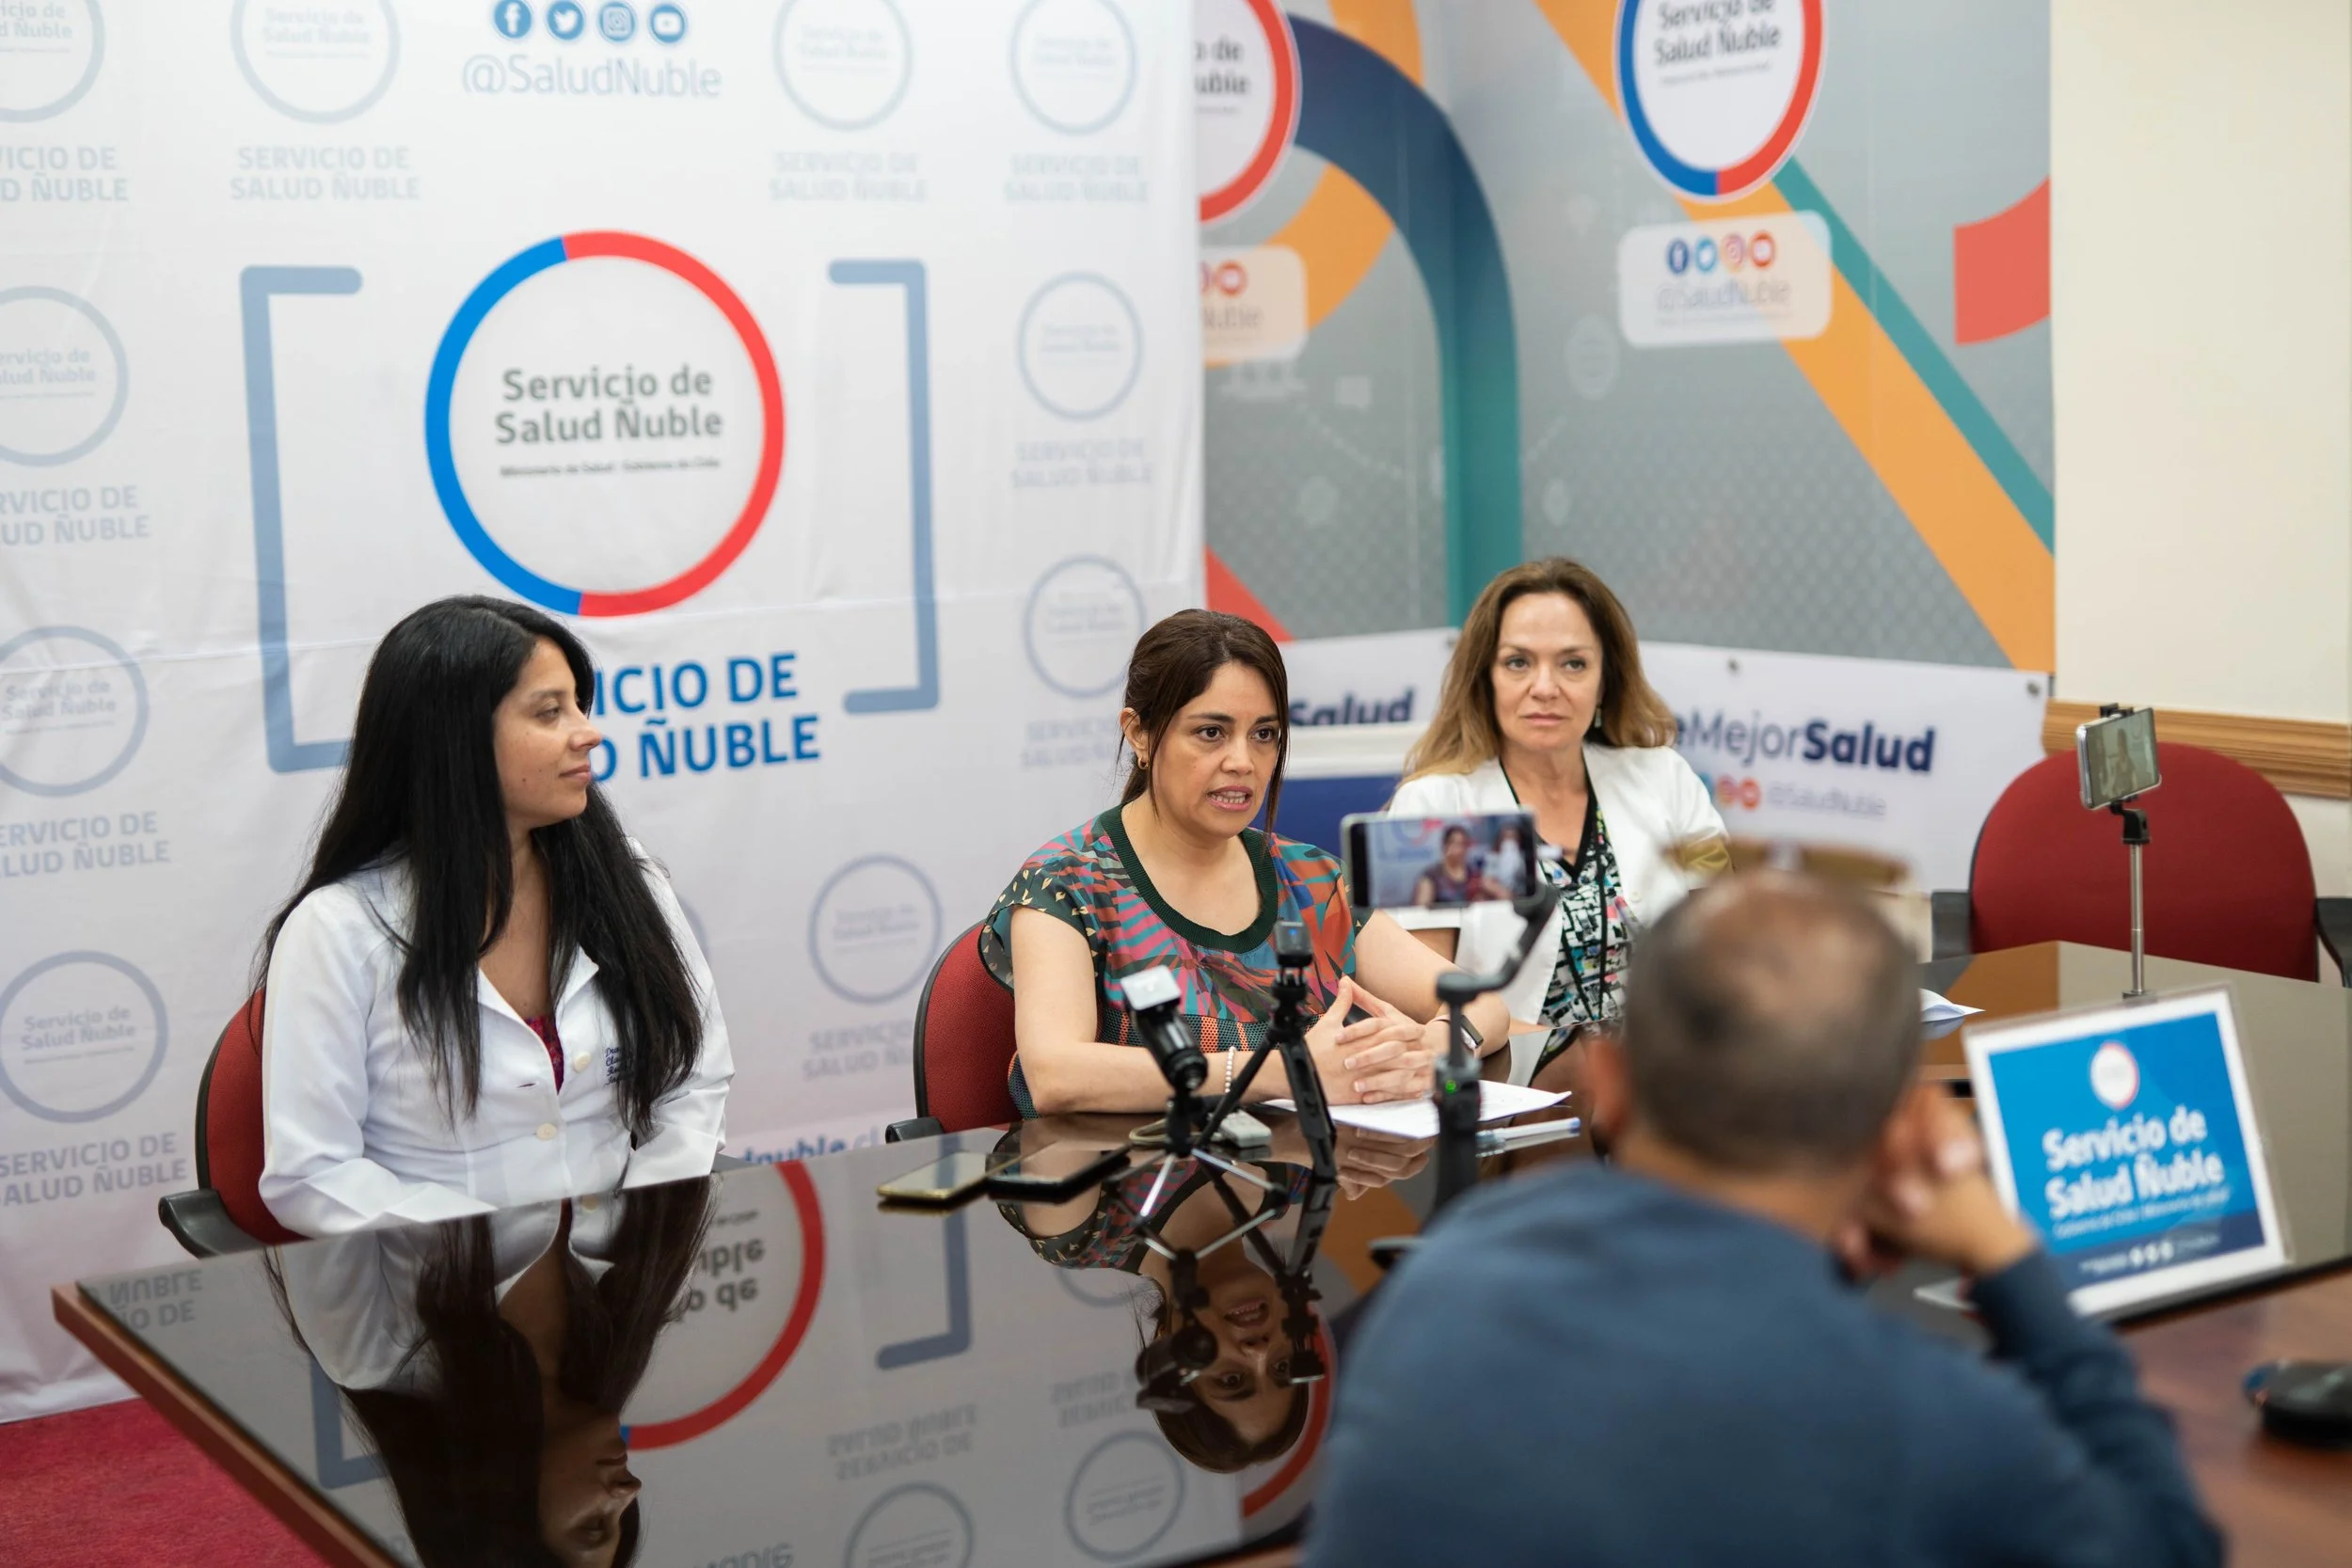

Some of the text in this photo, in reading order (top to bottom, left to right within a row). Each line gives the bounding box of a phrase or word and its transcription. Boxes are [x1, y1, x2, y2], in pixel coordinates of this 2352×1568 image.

[42, 1, 66, 19] de
[461, 54, 723, 99] @SaludNuble
[77, 145, 118, 172] DE
[236, 144, 410, 172] SERVICIO DE
[31, 170, 129, 202] ÑUBLE
[229, 171, 421, 202] SALUD ÑUBLE
[501, 361, 716, 404] Servicio de
[493, 397, 724, 447] Salud Ñuble
[0, 484, 139, 515] VICIO DE
[54, 513, 151, 545] ÑUBLE
[595, 651, 798, 717] ICIO DE
[1287, 688, 1413, 726] Salud
[639, 714, 820, 779] ÑUBLE
[1677, 710, 1936, 774] MejorSalud
[0, 811, 158, 847] RVICIO DE
[0, 839, 171, 878] LUD ÑUBLE
[24, 1005, 131, 1032] Servicio de
[21, 1029, 75, 1052] Salud
[139, 1132, 177, 1158] DE
[2042, 1104, 2208, 1172] Servicio de
[0, 1158, 186, 1208] ALUD ÑUBLE
[2044, 1163, 2134, 1220] Salud
[2134, 1150, 2226, 1200] Ñuble
